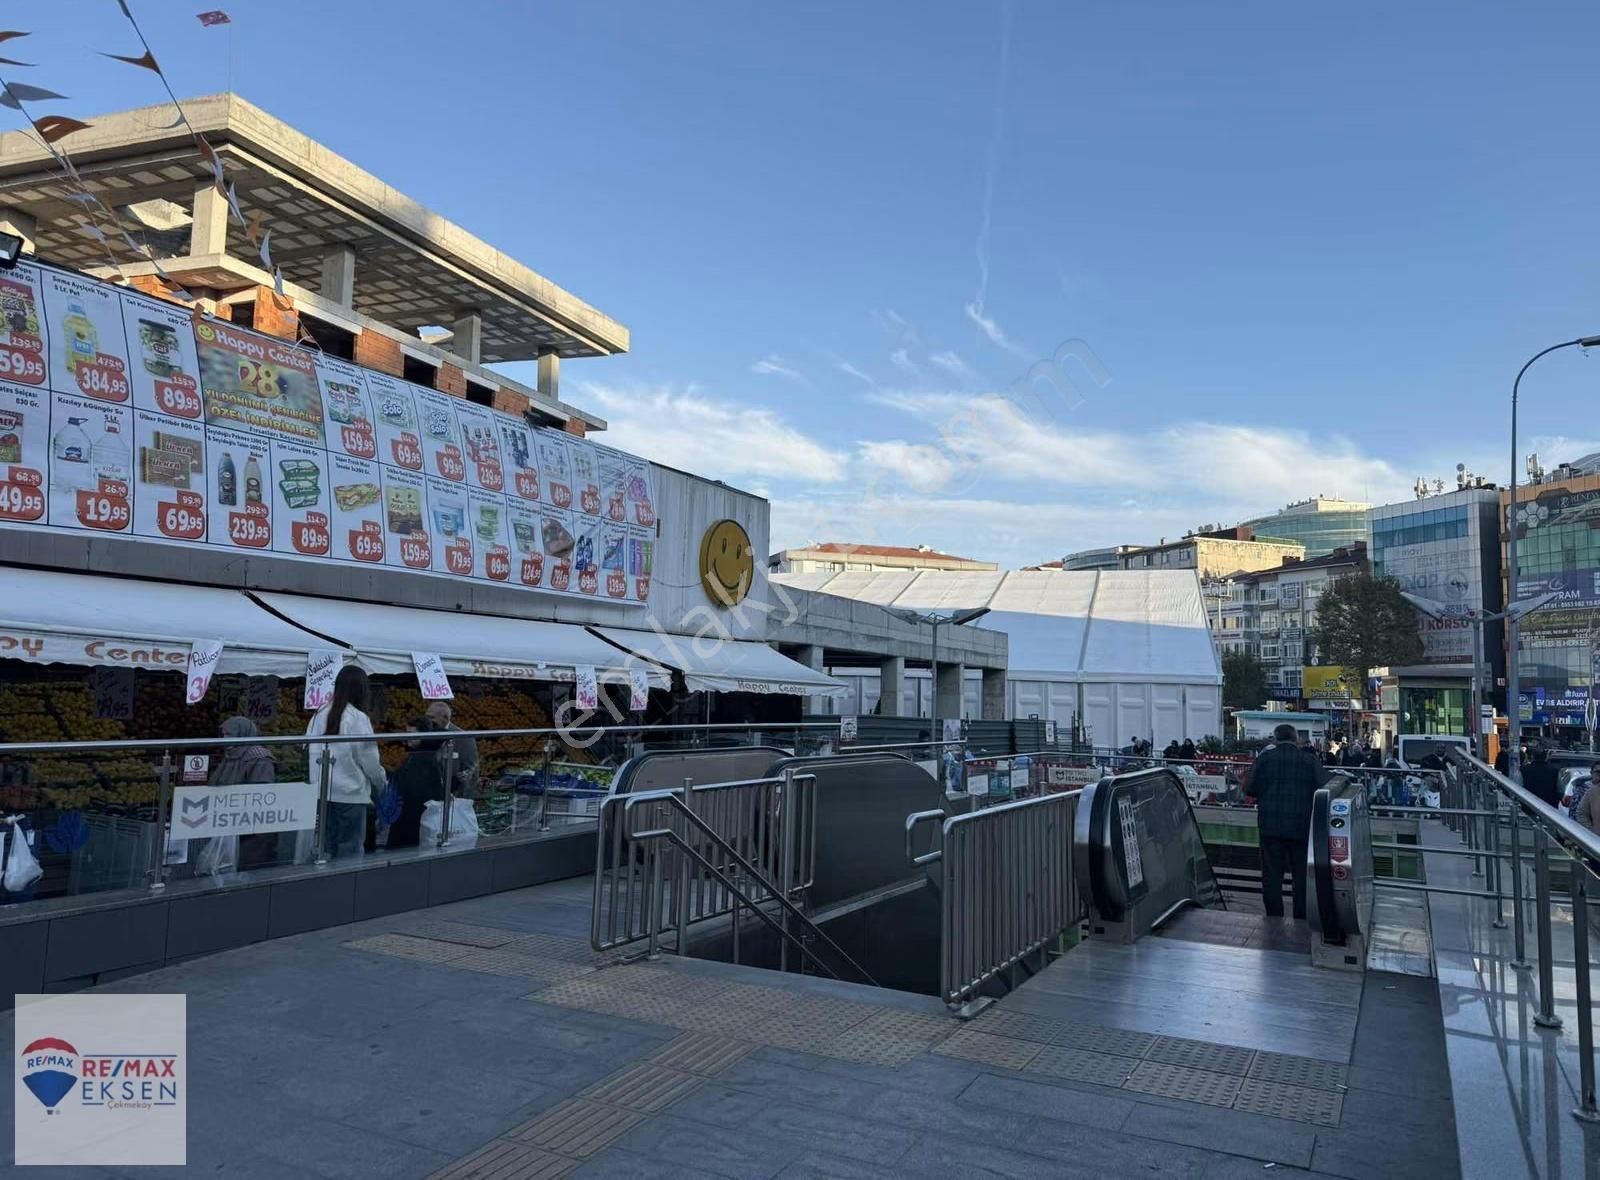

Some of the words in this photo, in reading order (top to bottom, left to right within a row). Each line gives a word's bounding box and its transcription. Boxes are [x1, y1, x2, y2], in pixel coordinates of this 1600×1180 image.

[215, 329, 264, 359] Happy
[268, 349, 312, 370] Center
[81, 366, 127, 397] 384,95
[164, 387, 199, 410] 89,95
[382, 404, 402, 417] Solo
[431, 424, 448, 435] Solo
[344, 431, 374, 452] 159,95
[86, 497, 128, 522] 19,95
[166, 509, 203, 532] 69,95
[232, 518, 269, 540] 239,95
[302, 529, 328, 547] 89,95
[357, 537, 382, 554] 69,95
[404, 542, 429, 561] 159,95
[85, 641, 189, 664] Cente
[472, 661, 535, 678] Happy
[737, 680, 769, 693] Happy
[779, 682, 807, 694] Center
[214, 791, 277, 809] METRO
[212, 808, 299, 829] İSTANBUL
